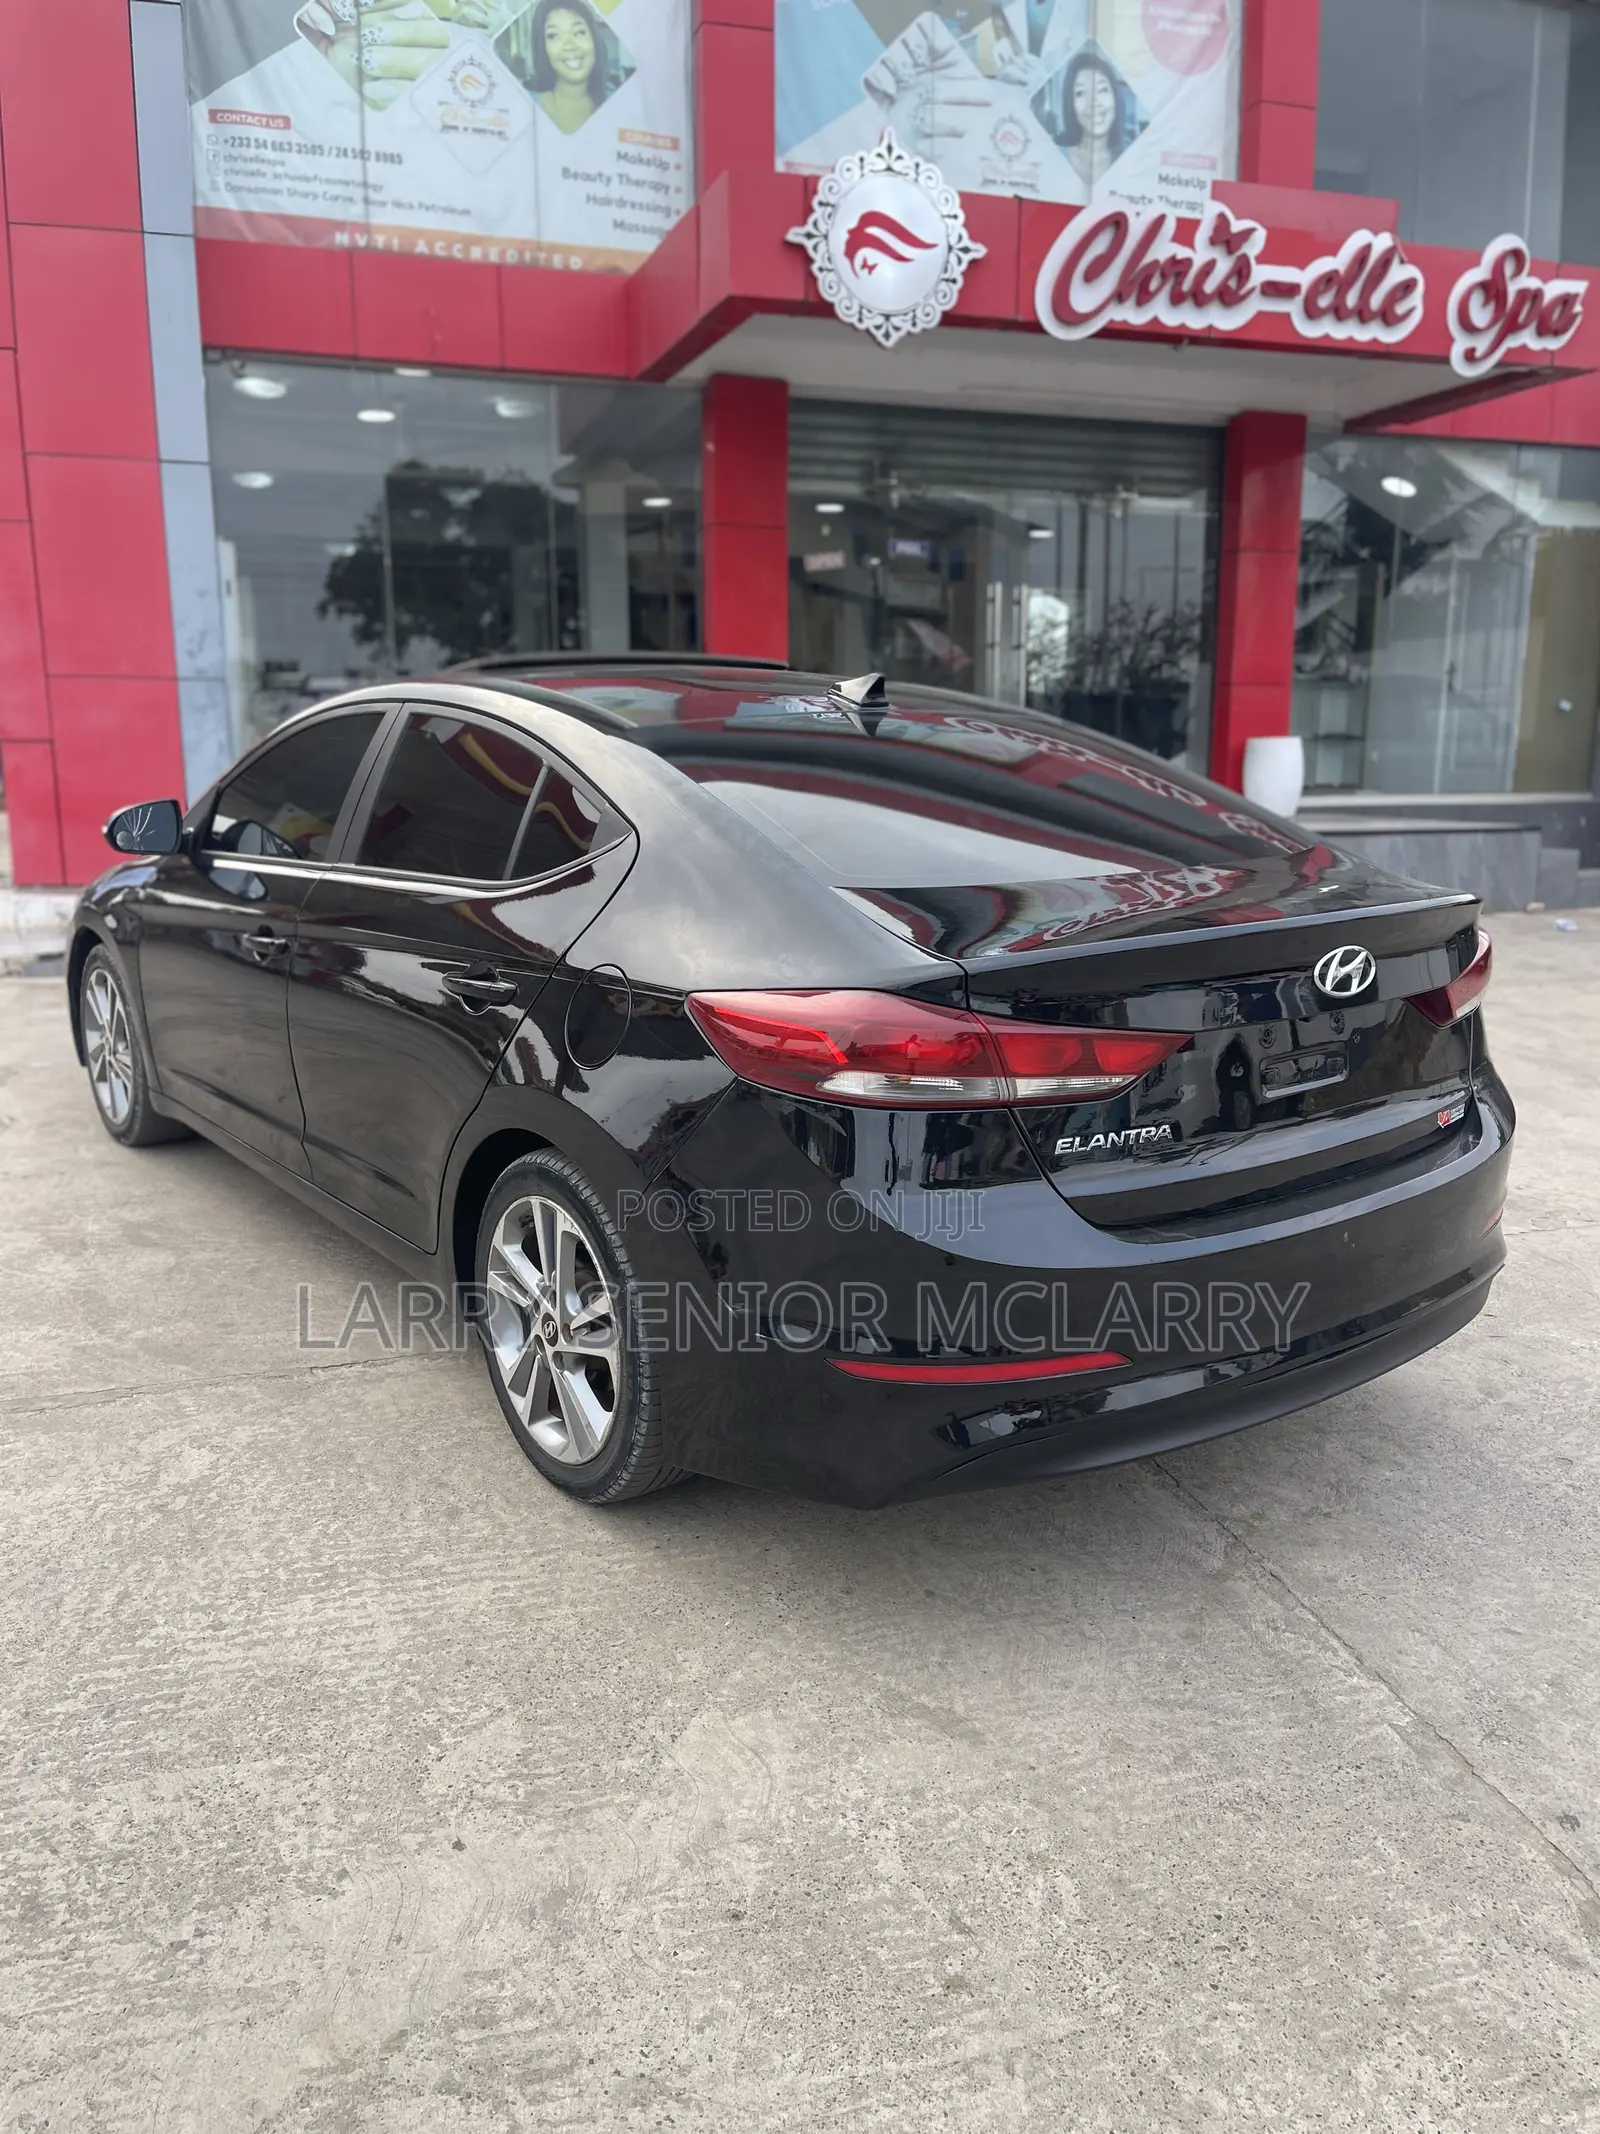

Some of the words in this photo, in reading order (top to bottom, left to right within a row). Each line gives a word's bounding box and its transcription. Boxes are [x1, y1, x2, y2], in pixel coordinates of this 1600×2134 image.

[216, 112, 267, 127] CONTACT
[269, 118, 285, 128] US
[223, 136, 252, 149] +233
[616, 151, 670, 172] MakeUp
[561, 166, 612, 187] Beauty
[617, 173, 670, 195] Therapy
[1158, 173, 1208, 191] MakeUp
[586, 193, 672, 219] Hairdressing
[414, 239, 583, 271] ACCREDITED
[1042, 206, 1421, 336] Chris-elle
[1453, 241, 1583, 368] Spa
[1054, 1124, 1173, 1155] ELANTRA
